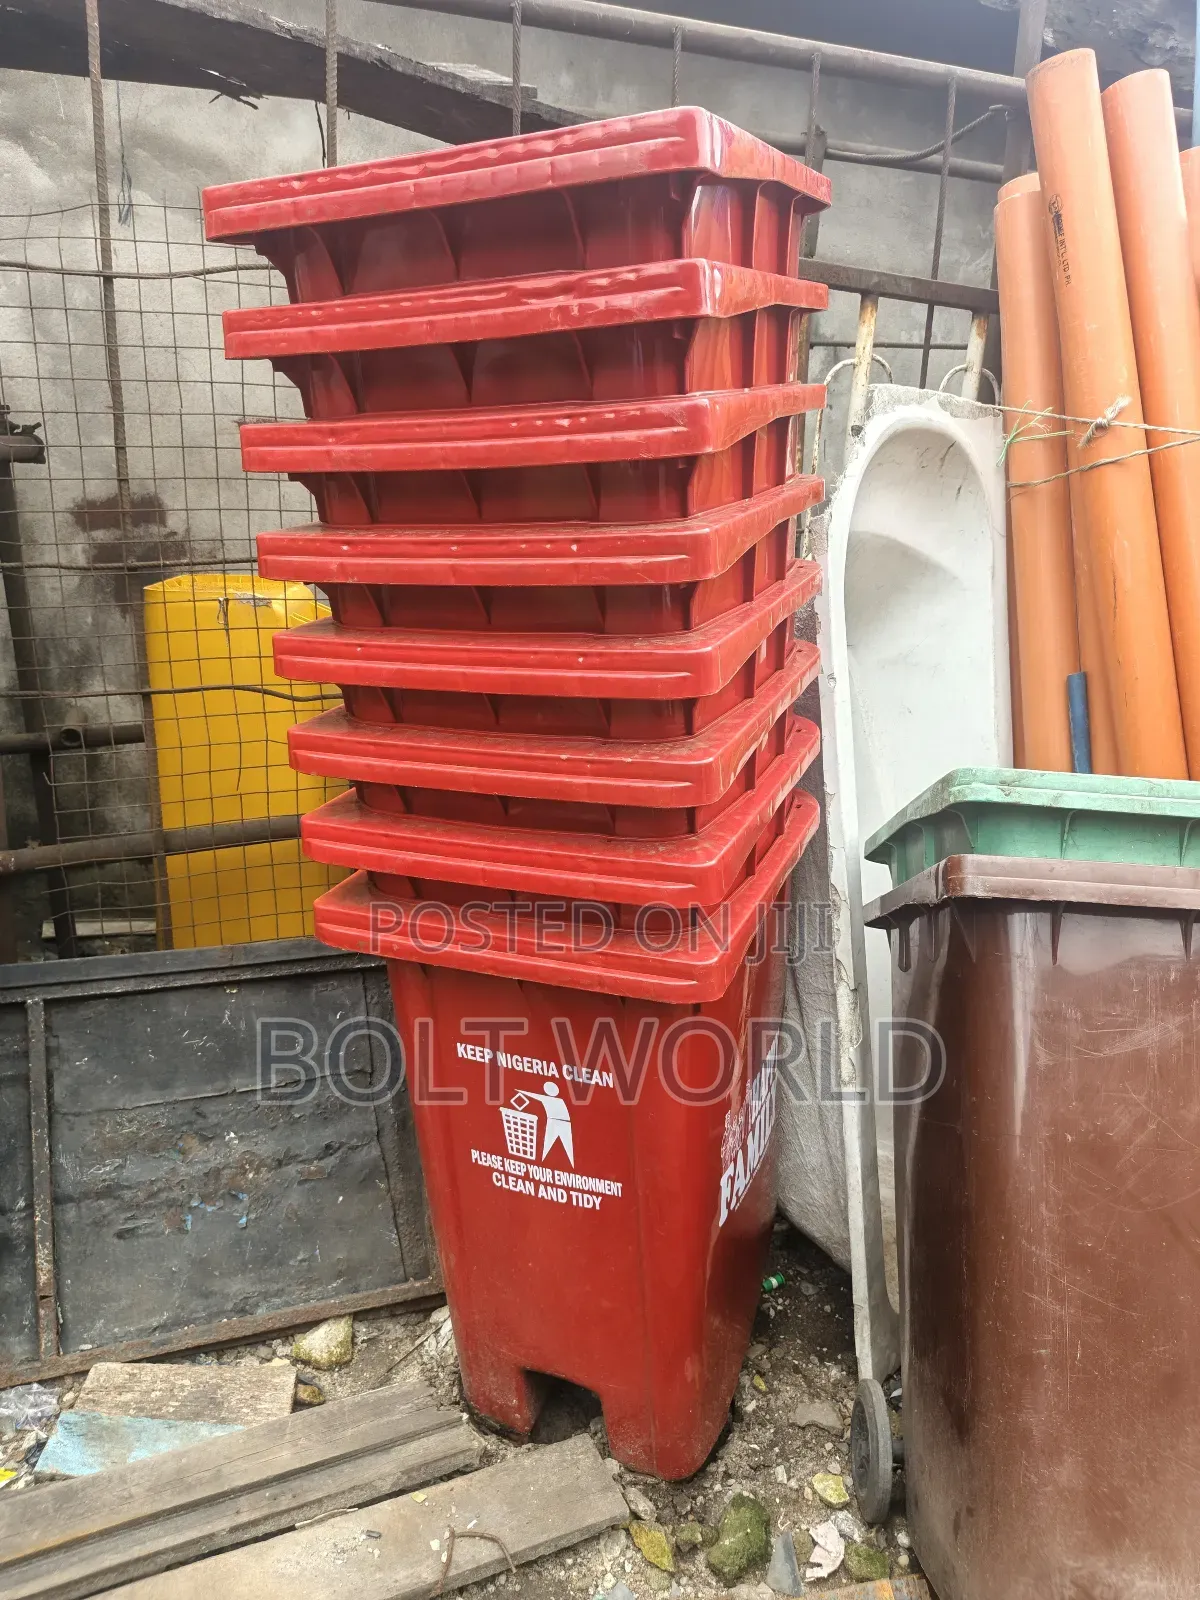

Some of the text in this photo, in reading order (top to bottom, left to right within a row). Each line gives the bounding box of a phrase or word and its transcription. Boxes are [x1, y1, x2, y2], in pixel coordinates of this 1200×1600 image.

[456, 1042, 614, 1088] KEEP NIGERIA CLEAN
[471, 1148, 623, 1197] PLEASE KEEP YOUR ENVIRONMENT
[492, 1171, 602, 1210] CLEAN AND TIDY
